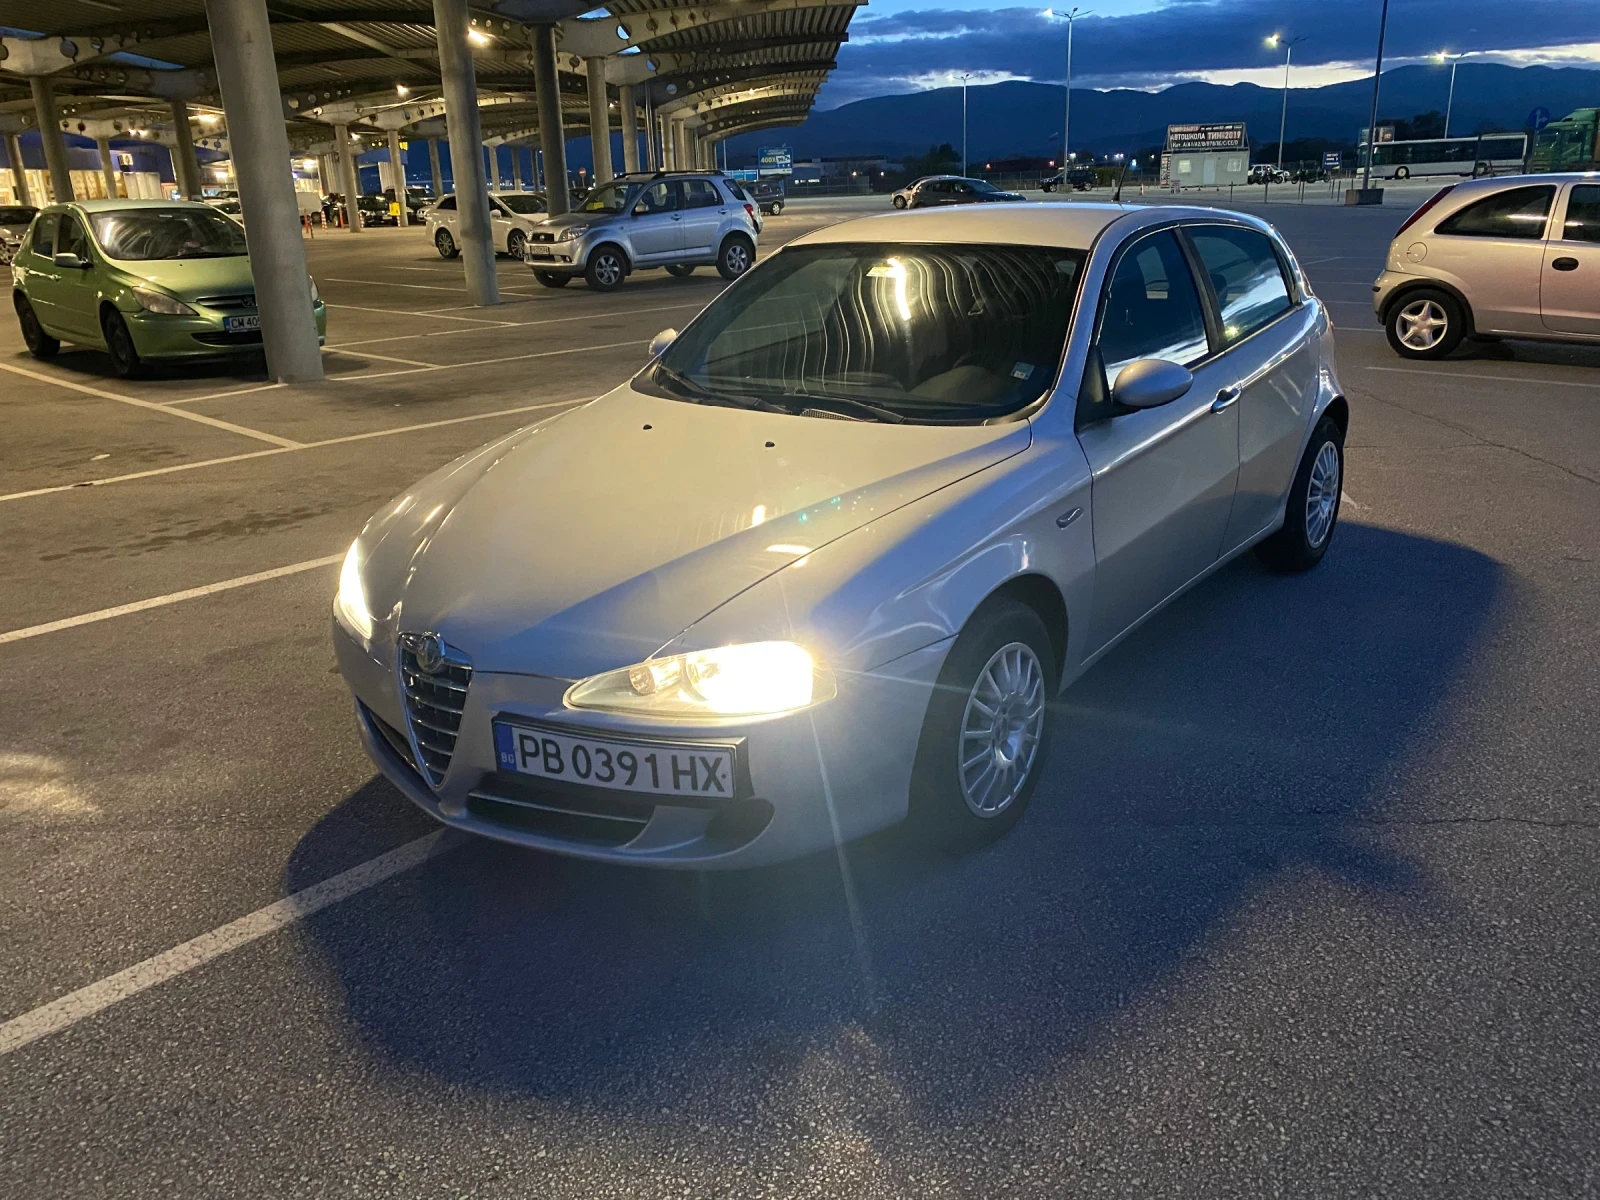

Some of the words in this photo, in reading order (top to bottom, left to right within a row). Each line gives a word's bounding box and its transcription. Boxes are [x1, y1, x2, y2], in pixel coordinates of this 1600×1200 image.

[1170, 133, 1205, 141] АВТОШКОЛА
[231, 318, 244, 328] CM
[501, 752, 515, 764] BG
[518, 733, 565, 775] PB
[571, 744, 660, 789] 0391
[671, 754, 725, 793] HX
